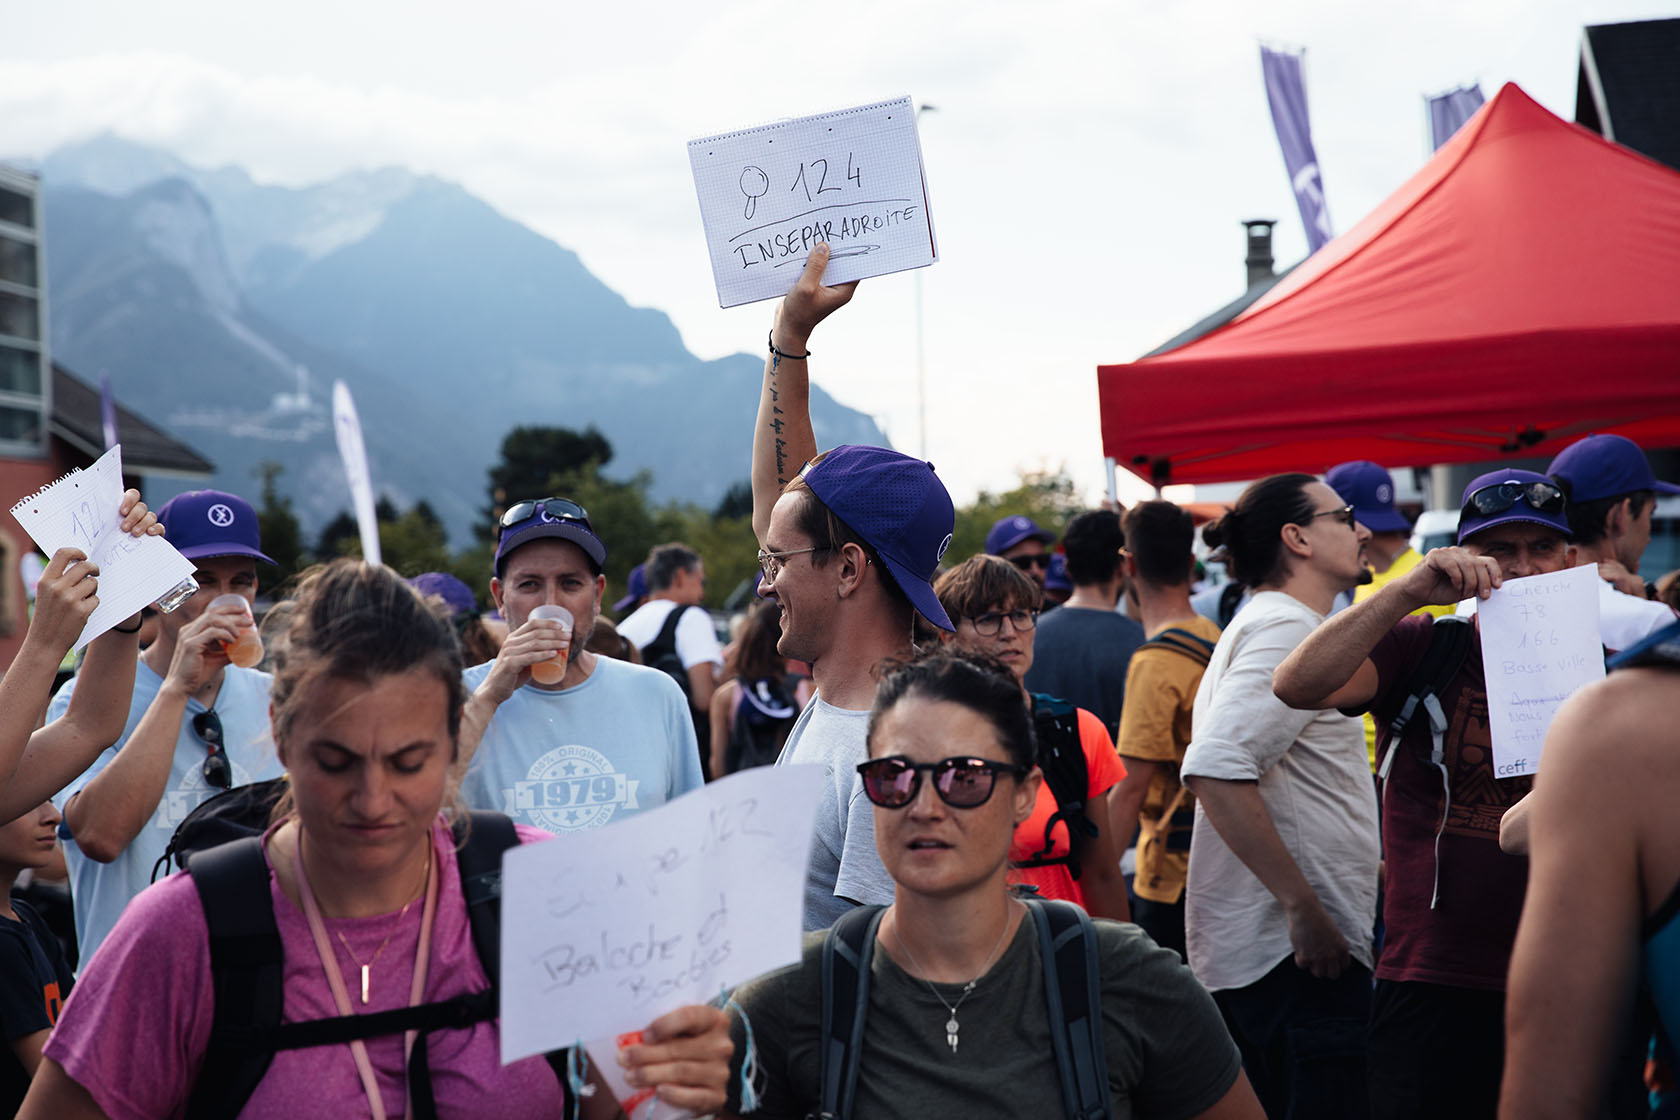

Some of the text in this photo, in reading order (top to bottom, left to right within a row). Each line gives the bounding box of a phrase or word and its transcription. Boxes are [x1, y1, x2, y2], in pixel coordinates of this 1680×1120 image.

[557, 746, 610, 772] ORIGINAL
[1497, 758, 1528, 776] ceff
[526, 776, 617, 807] 1979
